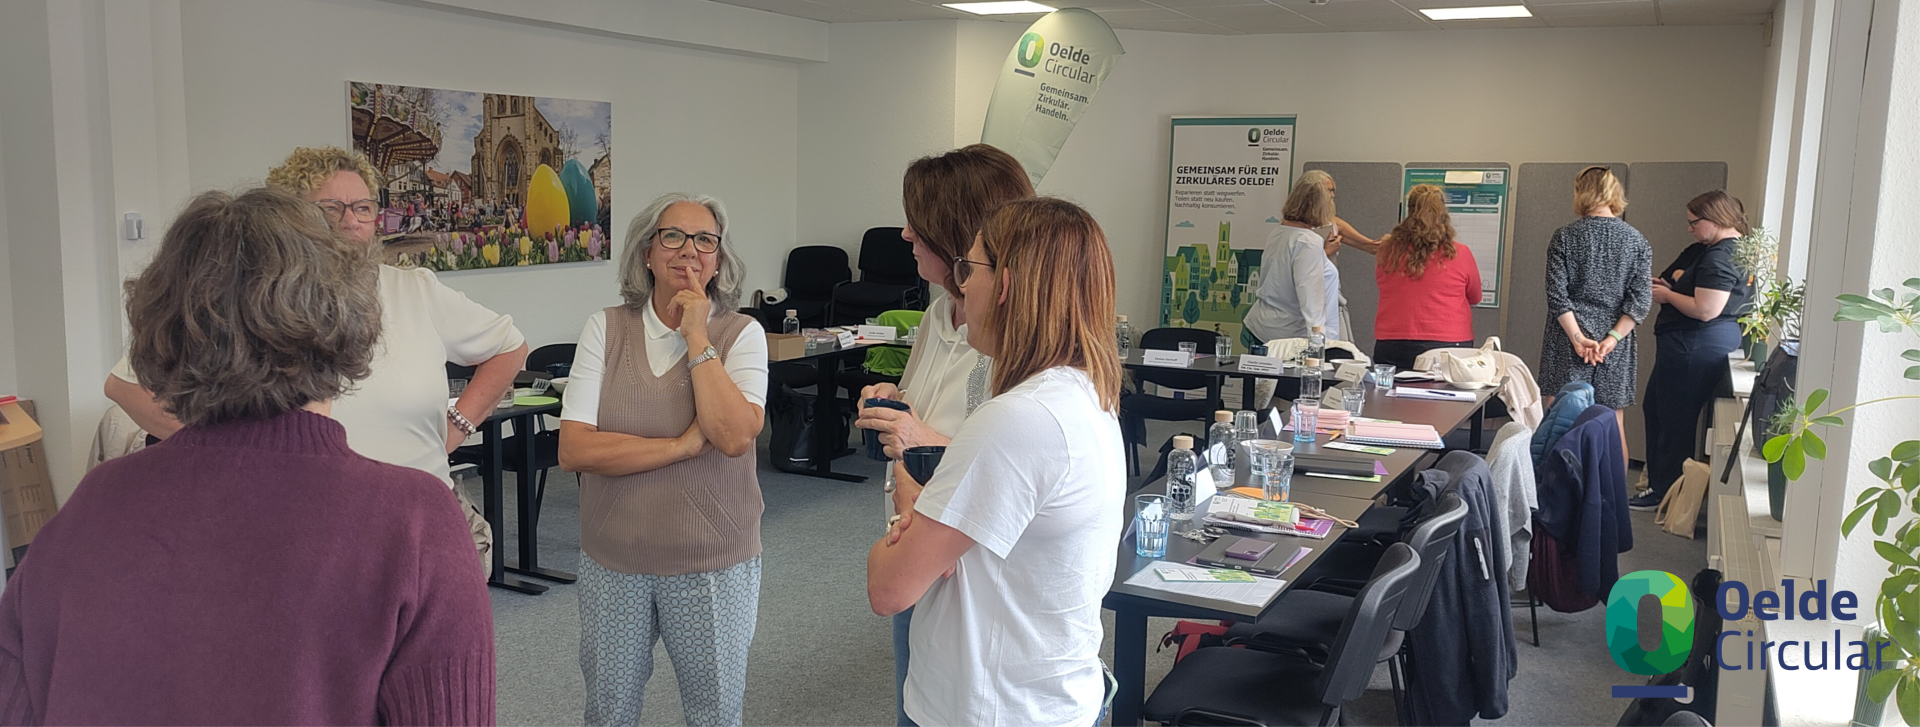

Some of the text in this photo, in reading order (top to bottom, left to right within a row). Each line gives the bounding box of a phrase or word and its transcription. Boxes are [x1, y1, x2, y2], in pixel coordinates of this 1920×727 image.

[1049, 42, 1090, 65] Oelde
[1044, 58, 1096, 84] Circular
[1037, 93, 1070, 110] Zirkulär.
[1040, 82, 1089, 104] Gemeinsam.
[1035, 104, 1069, 121] Handeln.
[1176, 164, 1279, 175] GEMEINSAM FÜR EIN
[1175, 175, 1275, 186] ZIRKULÄRES OELDE!
